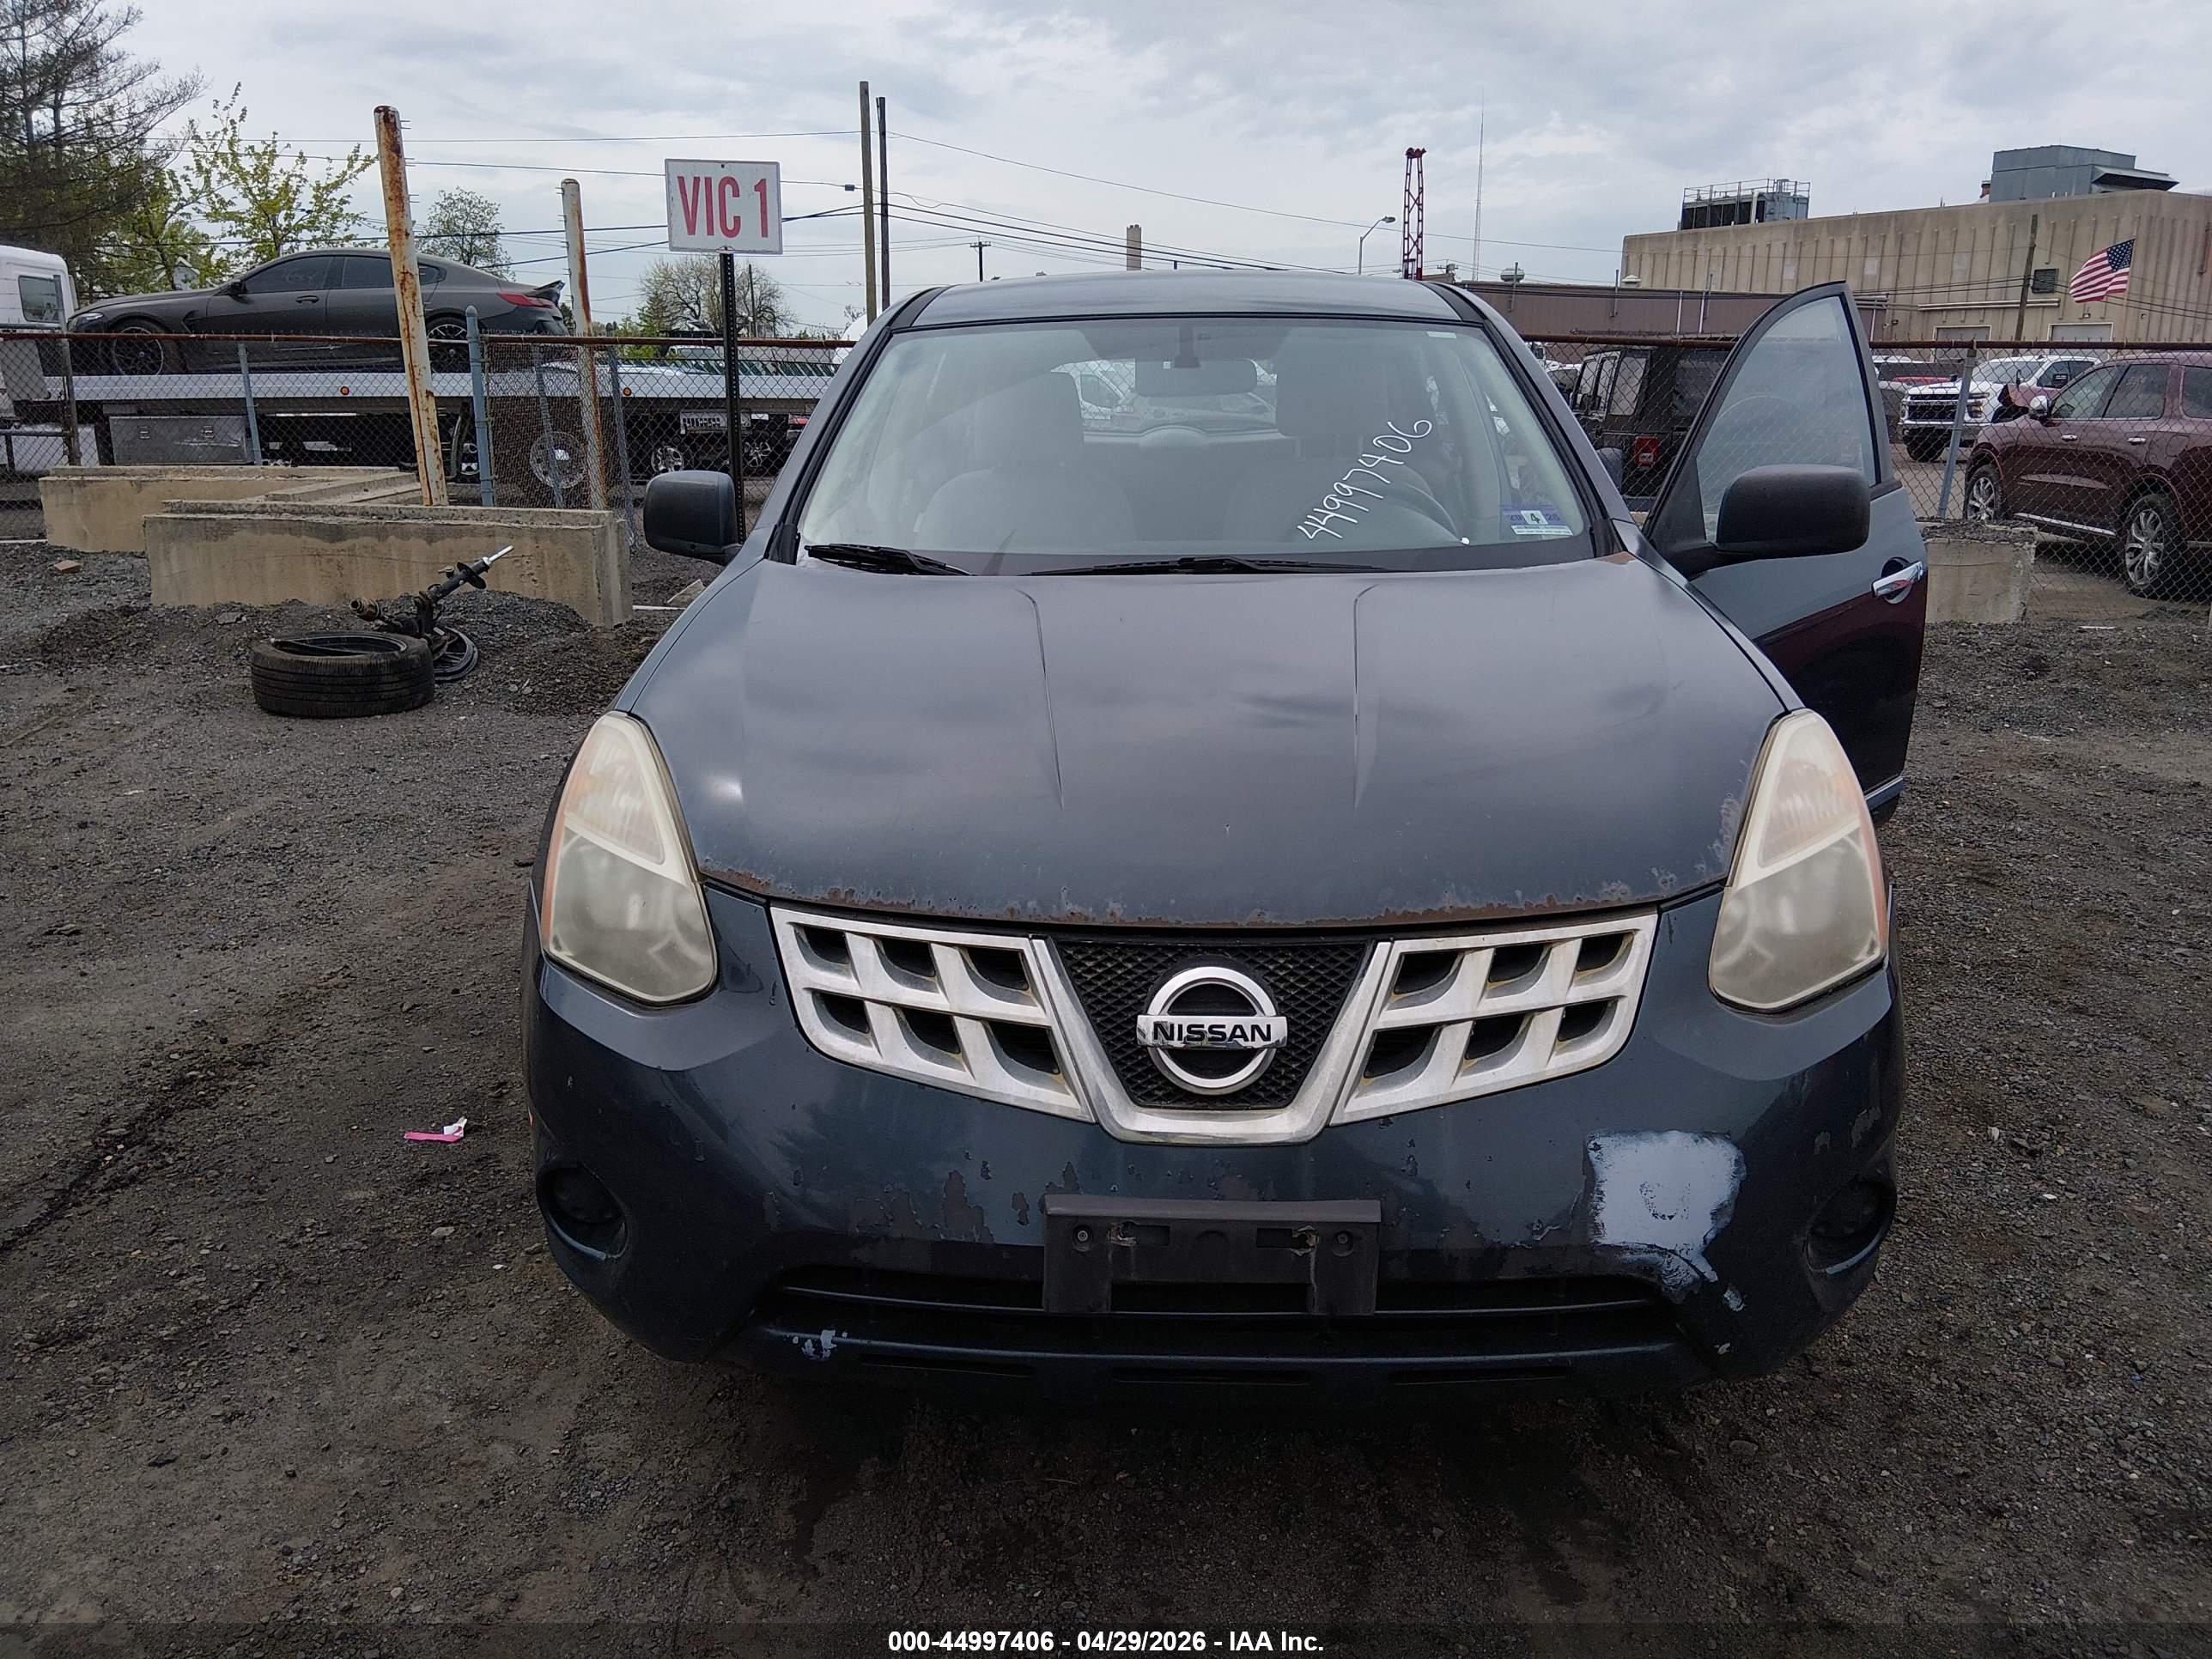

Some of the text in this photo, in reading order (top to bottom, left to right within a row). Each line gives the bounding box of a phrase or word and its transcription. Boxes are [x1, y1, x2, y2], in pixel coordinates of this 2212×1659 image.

[676, 175, 769, 238] VIC 1
[1297, 420, 1433, 540] 44997406
[1530, 513, 1541, 523] 4
[1152, 1022, 1272, 1042] NISSAN
